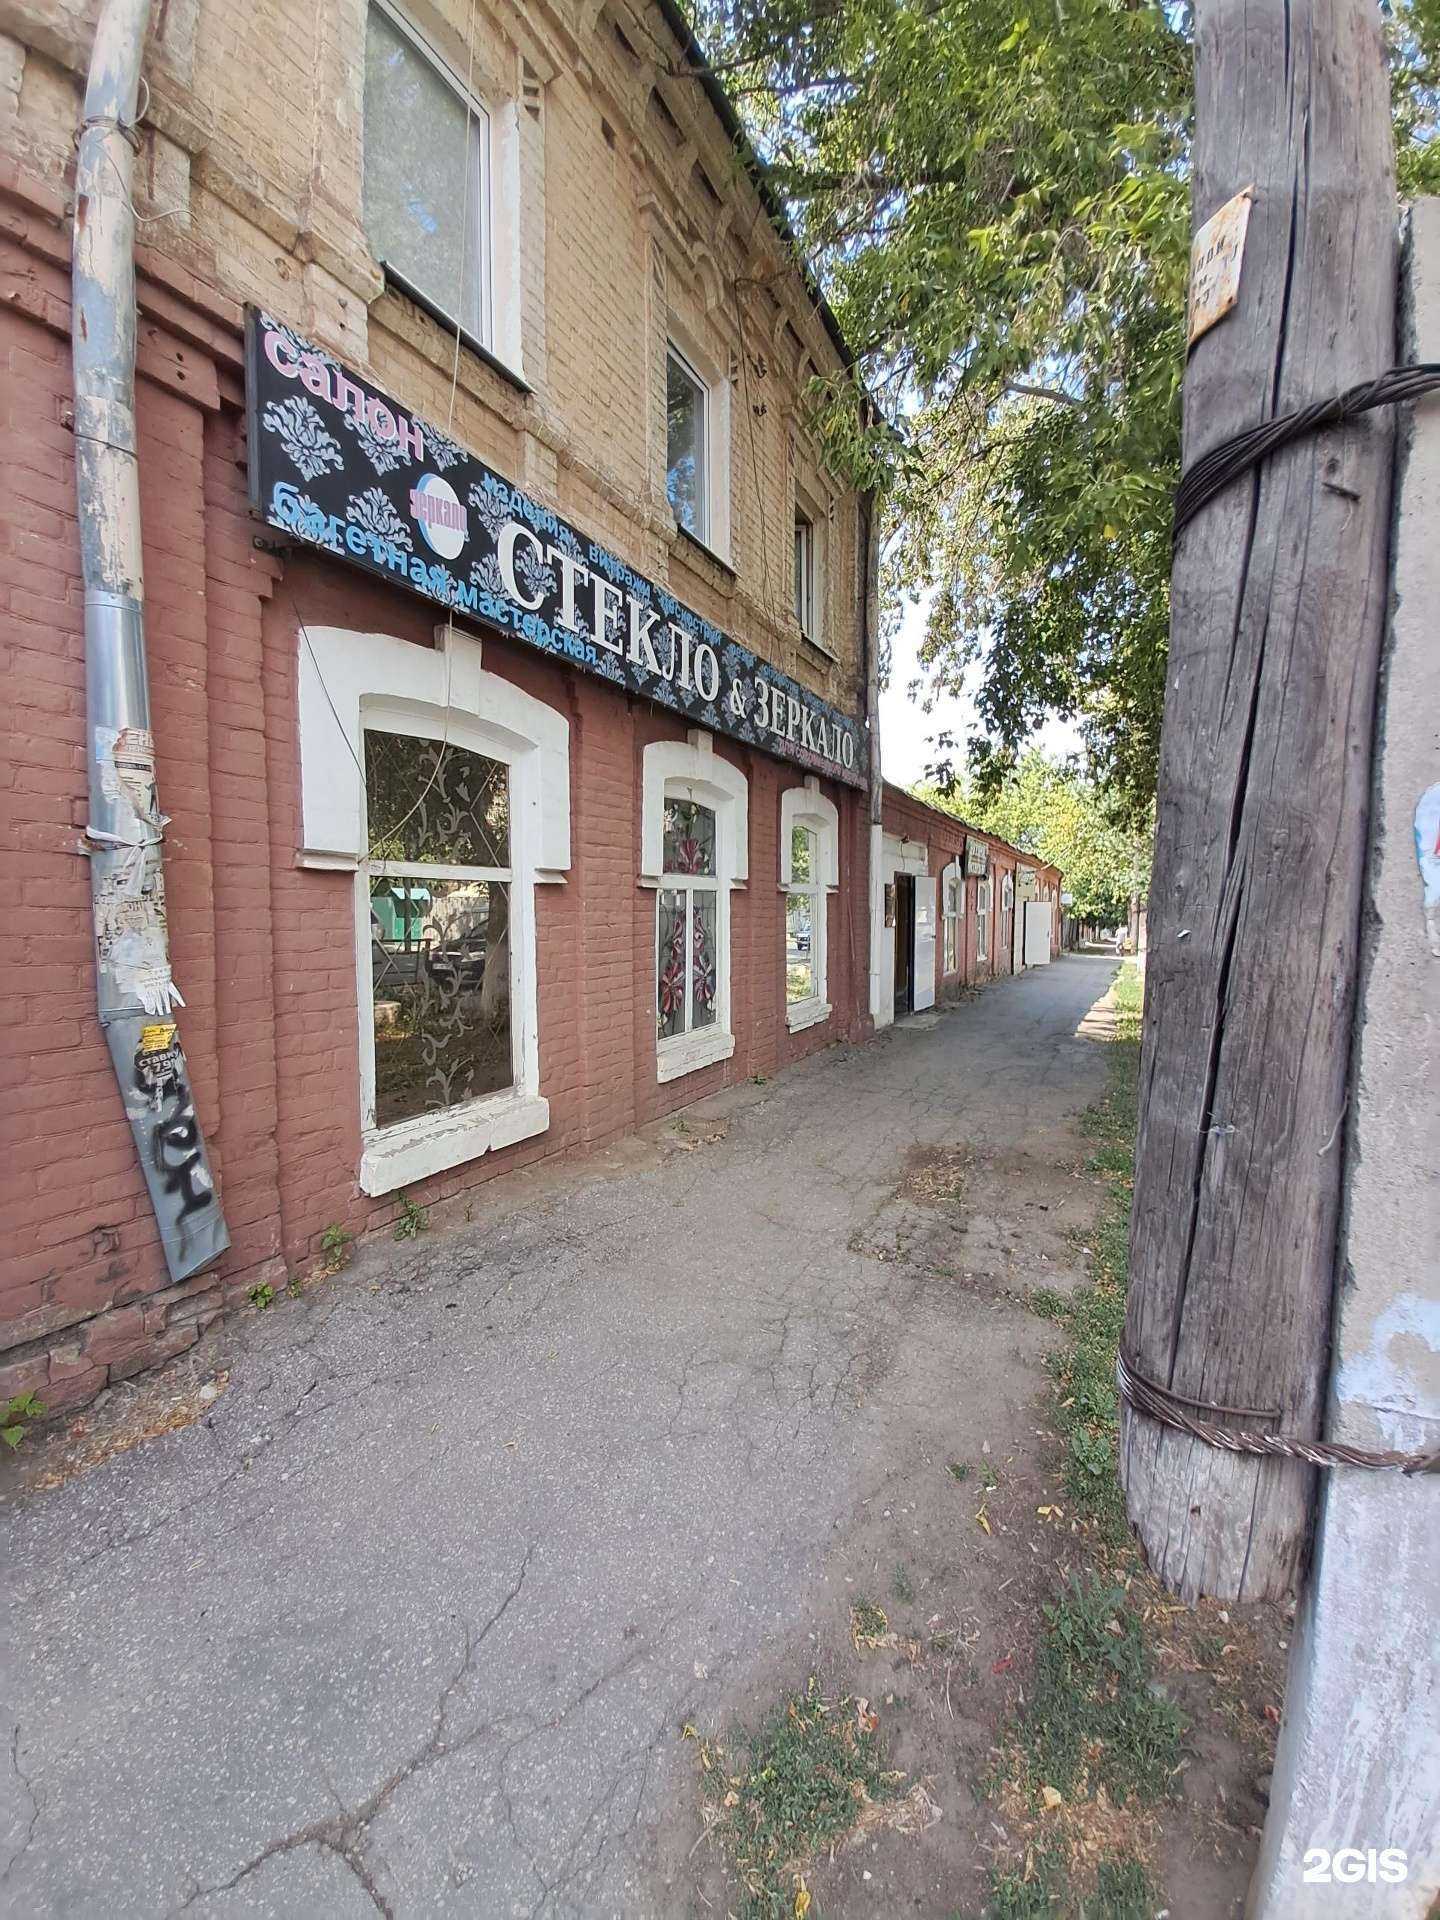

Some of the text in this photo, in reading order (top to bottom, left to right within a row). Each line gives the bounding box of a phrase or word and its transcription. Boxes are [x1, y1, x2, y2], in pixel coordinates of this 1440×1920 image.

[588, 543, 651, 600] витражи
[453, 579, 599, 666] мастерская
[497, 521, 719, 702] СТЕКЛО
[730, 677, 748, 720] &
[753, 675, 854, 769] ЗЕРКАЛО
